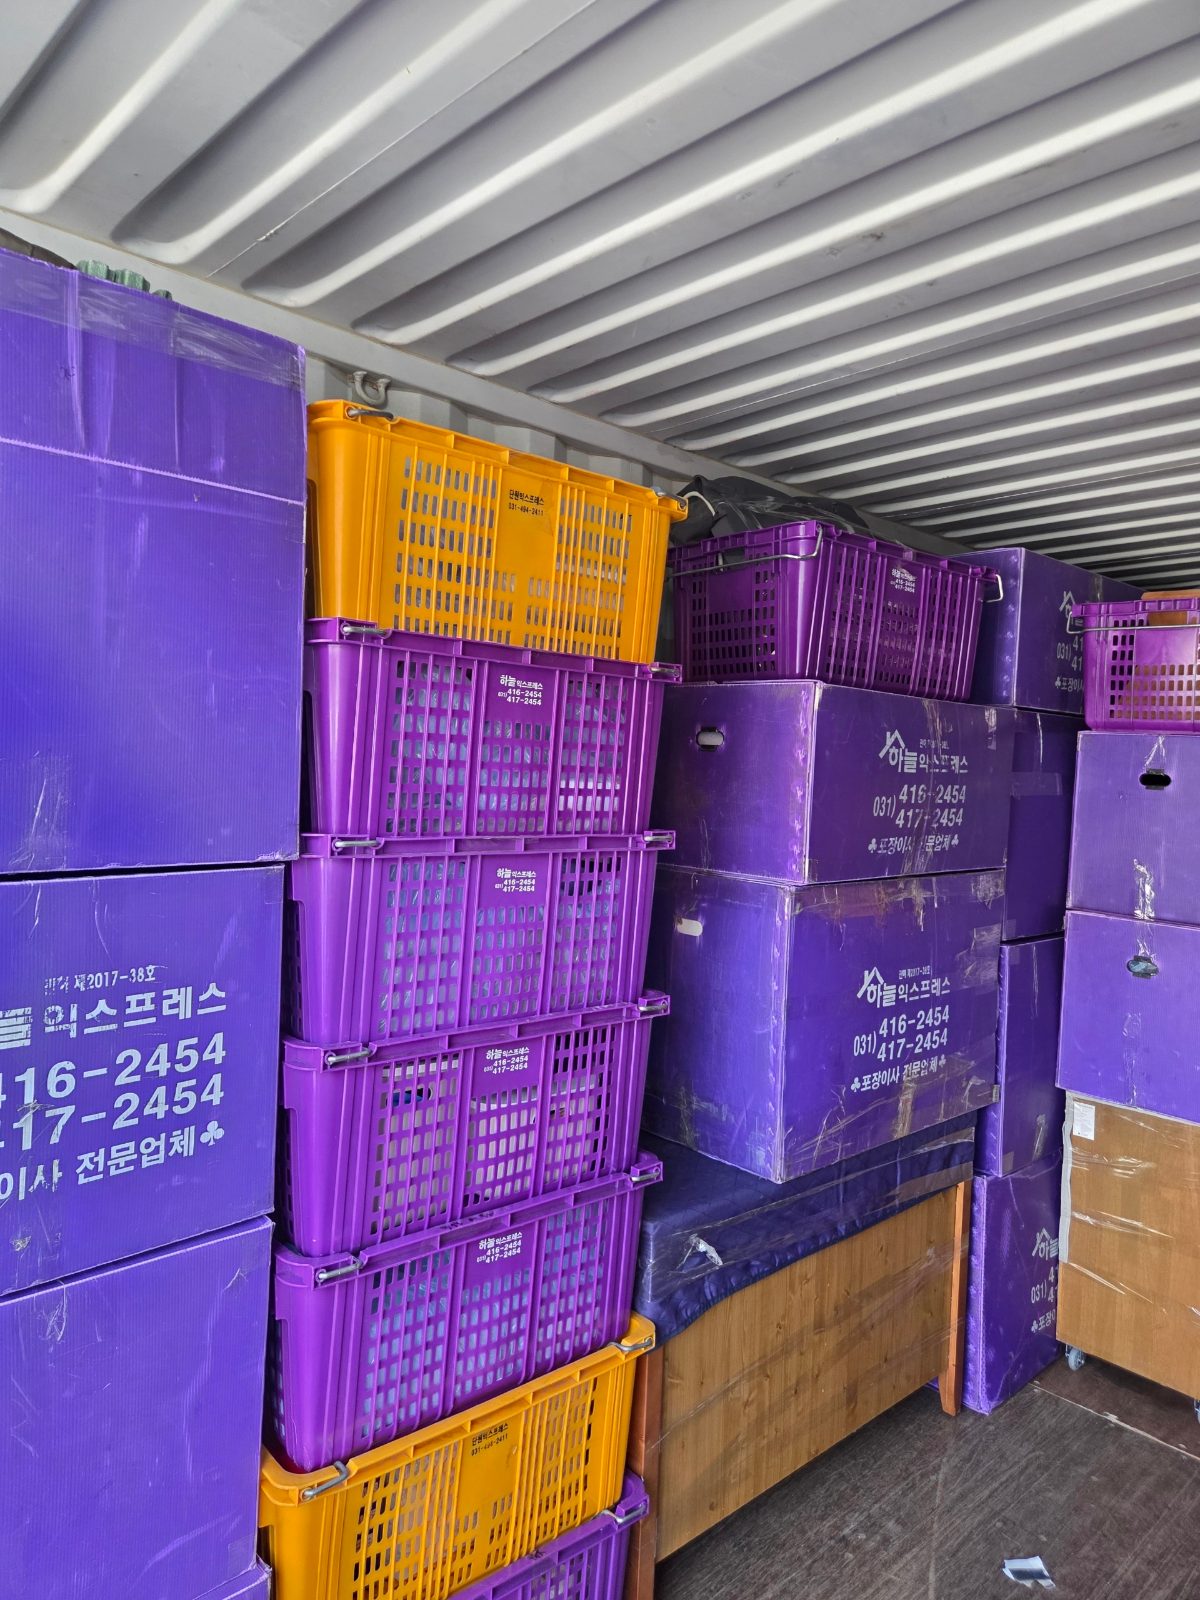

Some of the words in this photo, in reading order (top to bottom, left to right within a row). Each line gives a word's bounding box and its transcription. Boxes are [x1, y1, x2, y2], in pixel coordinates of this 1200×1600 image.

[506, 696, 542, 706] 417-2454
[507, 688, 542, 698] 416-2454
[888, 745, 918, 773] 하늘
[873, 795, 897, 818] 031)
[898, 784, 967, 804] 416-2454
[502, 885, 535, 893] 417-2454
[866, 982, 897, 1009] 하늘
[898, 976, 951, 1003] 익스프레스
[43, 982, 226, 1039] 익스프레스
[853, 1030, 877, 1057] 031)
[879, 1004, 950, 1038] 416-2454
[877, 1027, 948, 1062] 417-2454
[0, 1031, 227, 1110] 16-2454
[492, 1062, 528, 1075] 417-2454
[493, 1055, 529, 1067] 416-2454
[860, 1065, 900, 1092] 포장이사
[0, 1072, 225, 1152] 17-2454
[75, 1125, 196, 1186] 전문업체
[485, 1247, 521, 1264] 417-2454
[486, 1239, 522, 1256] 416-2454
[1030, 1279, 1047, 1304] 031)
